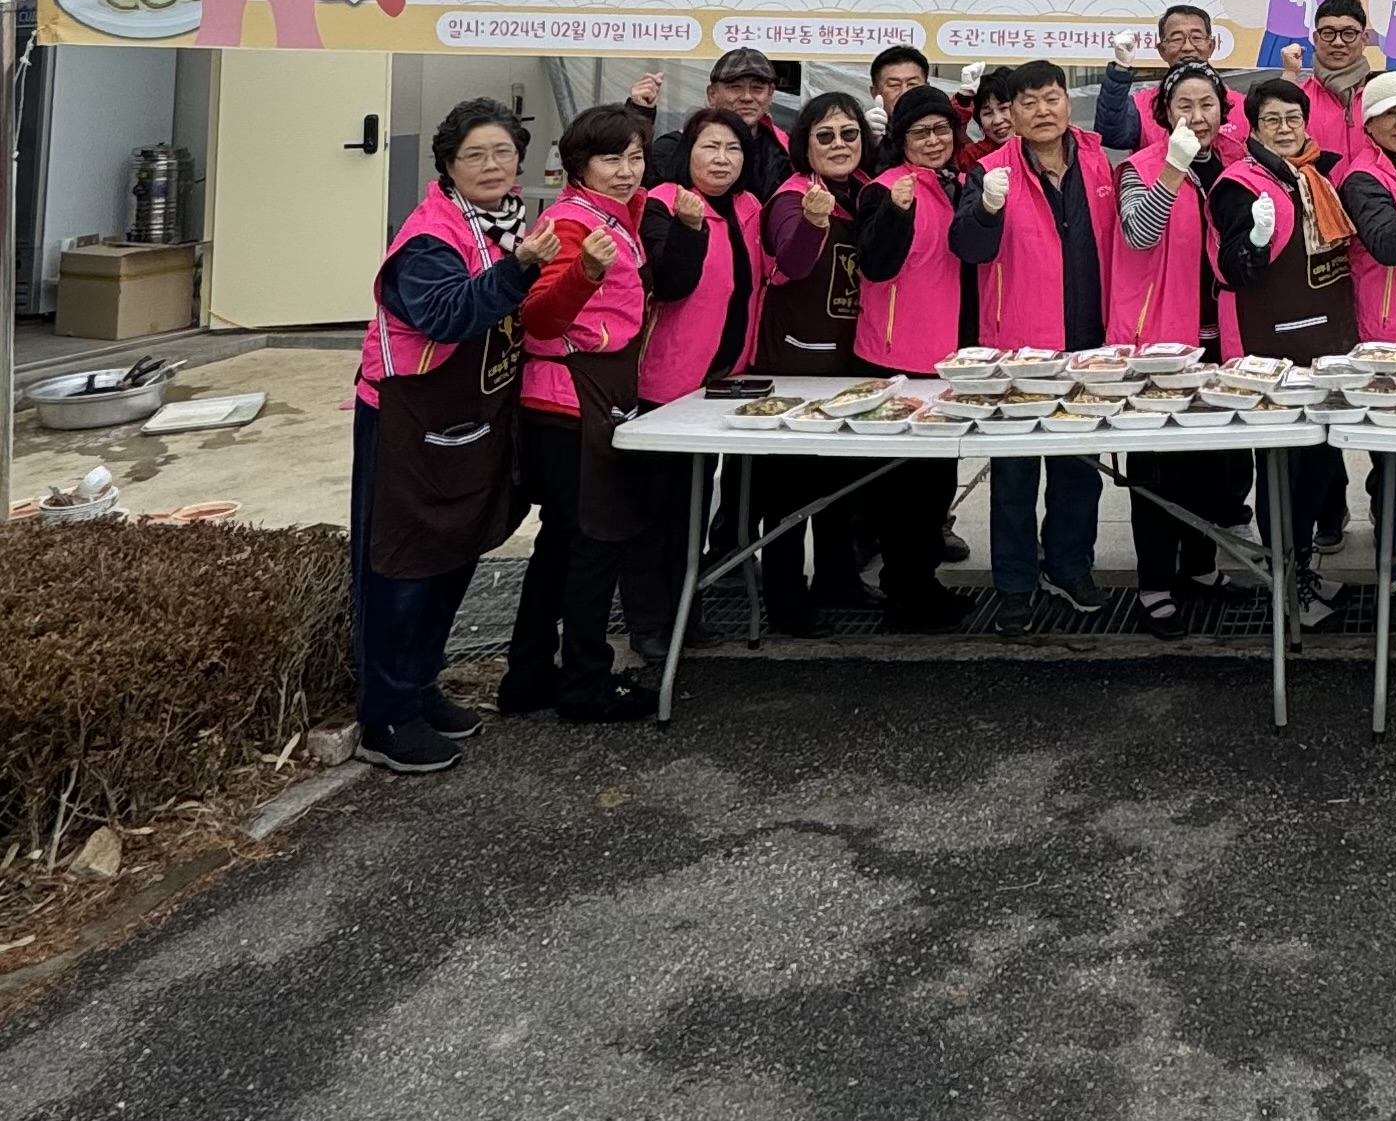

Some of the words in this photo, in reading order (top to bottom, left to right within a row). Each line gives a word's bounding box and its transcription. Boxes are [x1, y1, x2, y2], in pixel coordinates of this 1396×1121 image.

[448, 20, 485, 39] 일시:
[489, 20, 547, 40] 2024년
[550, 20, 587, 41] 02월
[591, 22, 627, 42] 07일
[631, 22, 691, 41] 11시부터
[724, 24, 762, 44] 장소:
[766, 24, 814, 45] 대부동
[818, 24, 915, 46] 행정복지센터
[949, 28, 985, 47] 주관:
[990, 29, 1037, 49] 대부동
